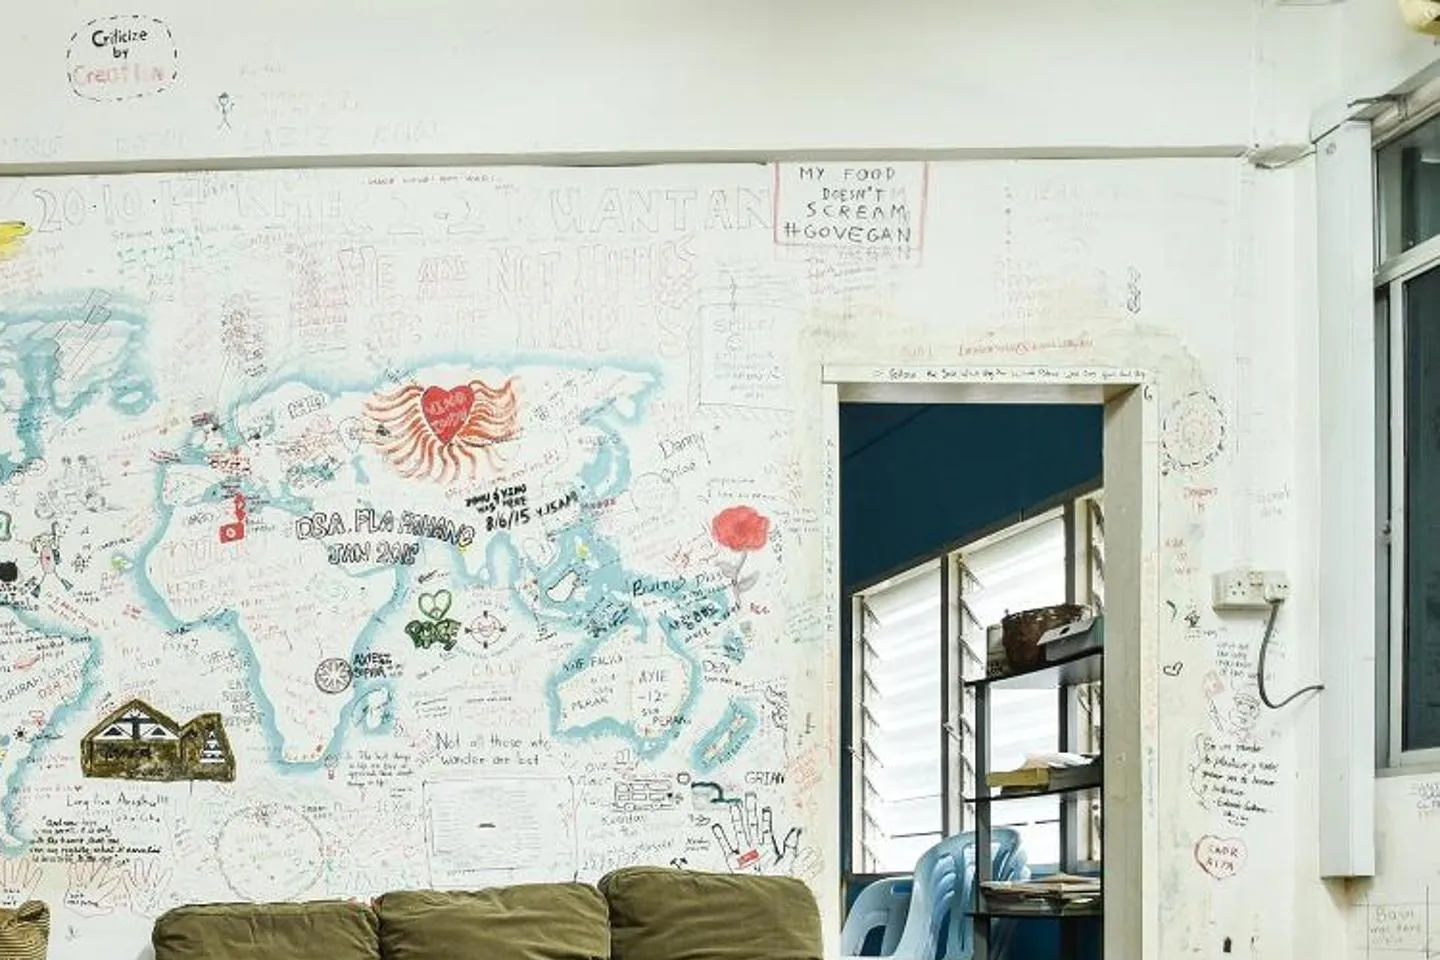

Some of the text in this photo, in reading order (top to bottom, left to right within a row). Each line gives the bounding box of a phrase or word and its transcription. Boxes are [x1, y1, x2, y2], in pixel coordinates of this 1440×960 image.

[92, 28, 148, 47] Criticize
[113, 46, 128, 59] by
[800, 166, 896, 181] MY FOOD
[822, 186, 888, 202] DOESN'T
[806, 202, 908, 220] SCREAM
[784, 222, 911, 242] #GOVEGAN
[435, 731, 460, 750] Not
[491, 731, 522, 748] those
[440, 752, 486, 766] wander
